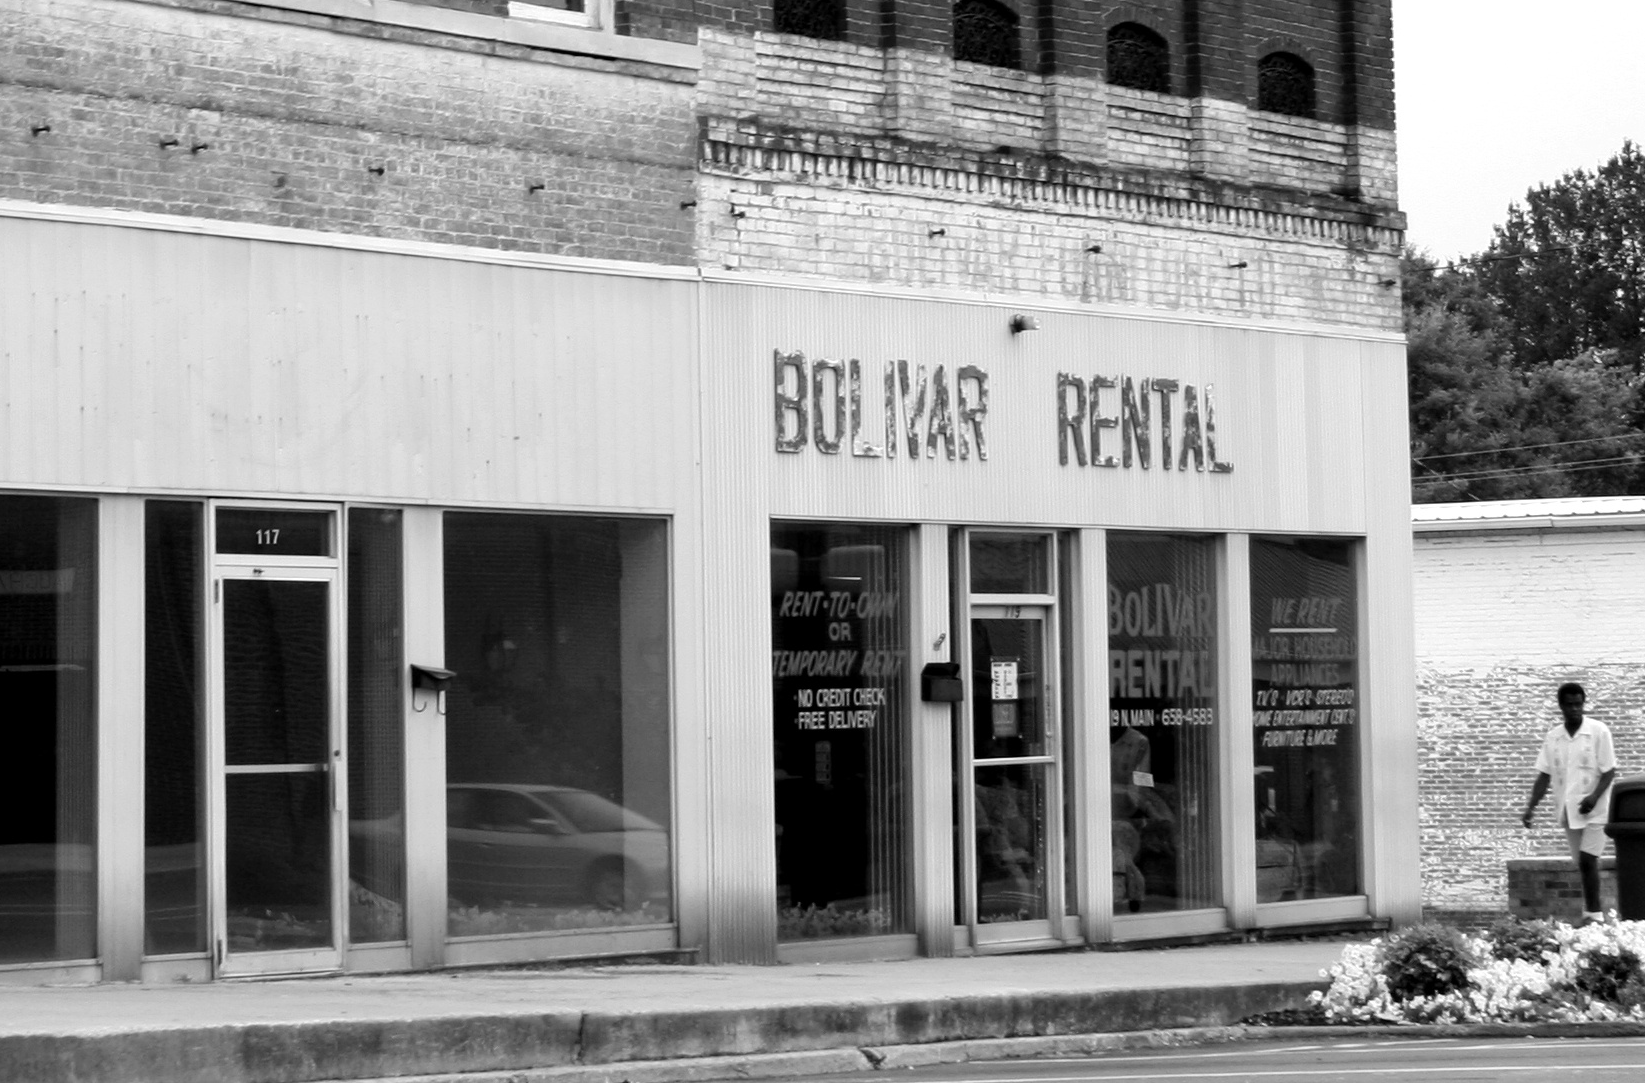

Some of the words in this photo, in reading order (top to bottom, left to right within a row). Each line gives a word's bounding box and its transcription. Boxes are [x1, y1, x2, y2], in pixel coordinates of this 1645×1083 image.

[773, 348, 988, 460] BOLIVAR
[1056, 370, 1234, 473] RENTAL
[256, 528, 280, 545] 117
[1109, 583, 1214, 637] BOLIVAR
[1271, 597, 1295, 624] WE
[1296, 597, 1341, 624] RENT
[828, 622, 852, 641] OR
[772, 650, 858, 677] TEMPORARY
[860, 650, 907, 677] RENT
[1109, 650, 1214, 698] RENTAL
[798, 689, 813, 707] NO
[816, 688, 851, 707] CREDIT
[854, 688, 886, 706] CHECK
[798, 711, 825, 729] FREE
[828, 710, 877, 729] DELIVERY
[1130, 709, 1155, 727] MAIN
[1273, 709, 1330, 727] ENTERTAINMENT
[1262, 730, 1305, 747] FURNITURE
[1312, 729, 1338, 746] MORE
